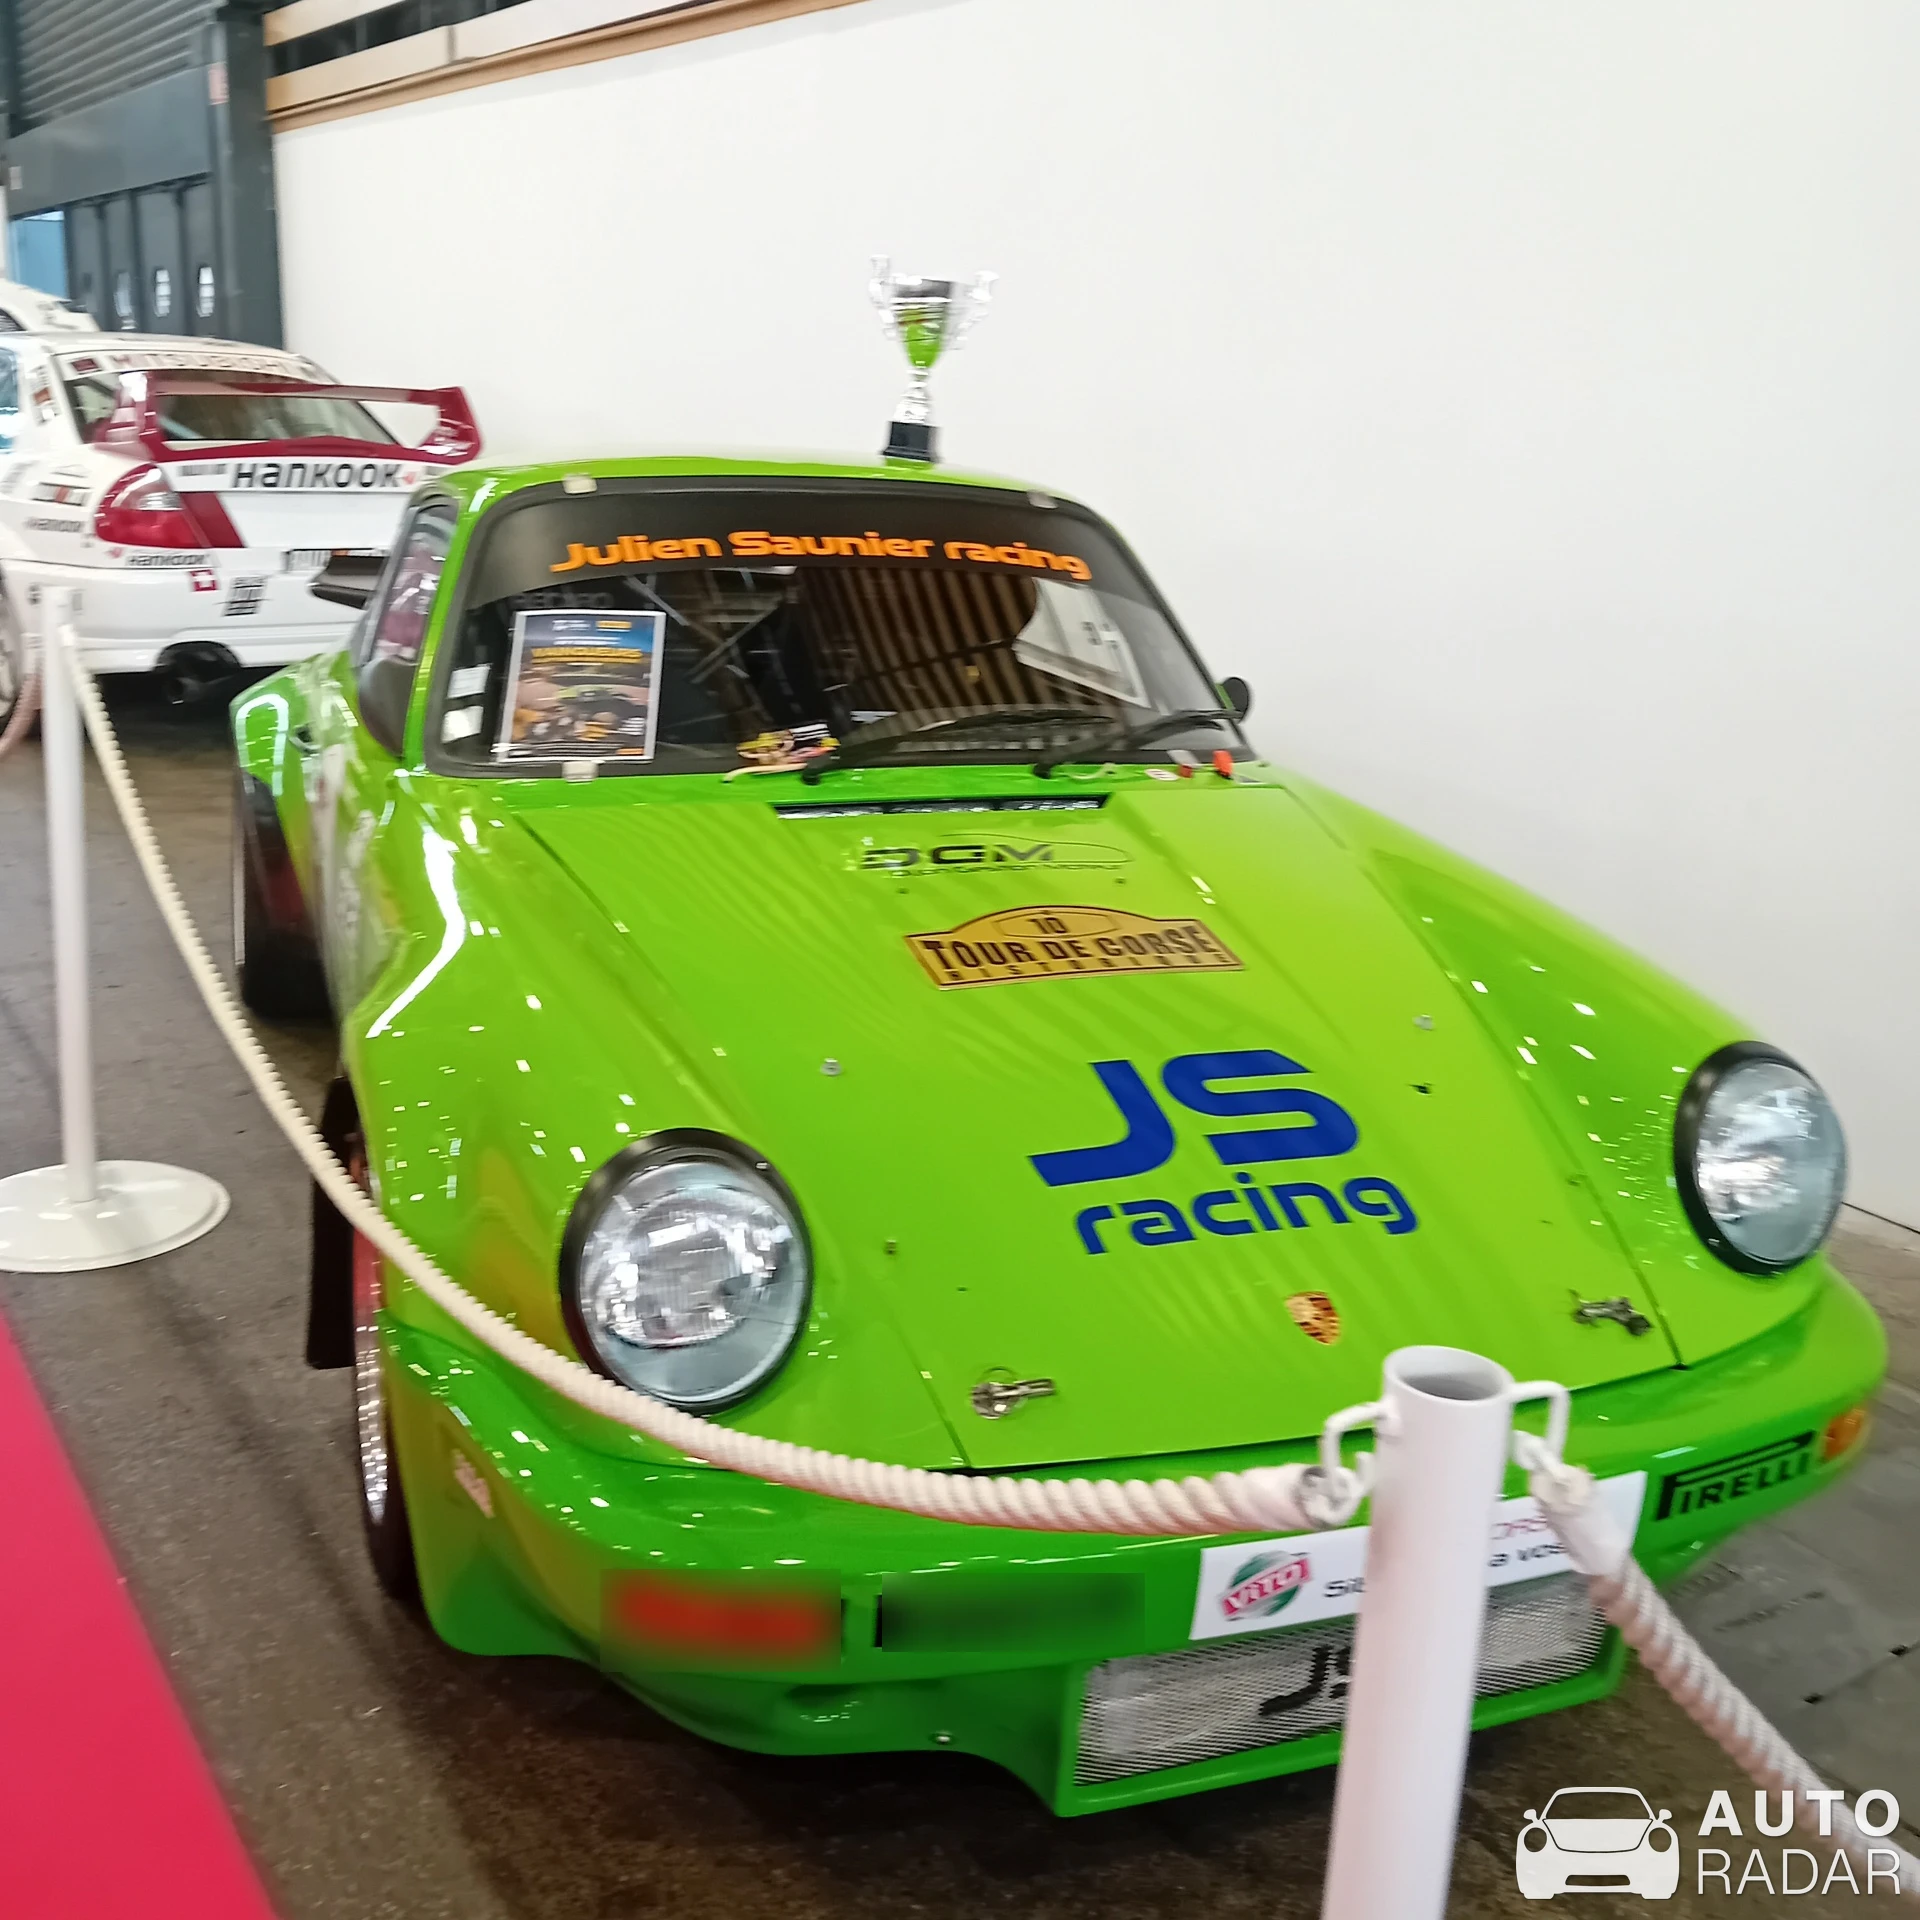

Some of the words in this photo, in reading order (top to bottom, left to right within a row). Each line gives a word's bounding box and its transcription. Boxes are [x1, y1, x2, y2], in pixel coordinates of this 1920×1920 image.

[549, 535, 723, 573] Julien
[727, 530, 934, 558] Saunier
[945, 542, 1092, 581] racing
[921, 940, 1037, 970] TOUR
[1038, 937, 1094, 960] DE
[1094, 925, 1222, 956] CORSE
[1028, 1049, 1358, 1187] JS
[1075, 1172, 1419, 1255] racing
[1655, 1429, 1817, 1522] PIRELLI
